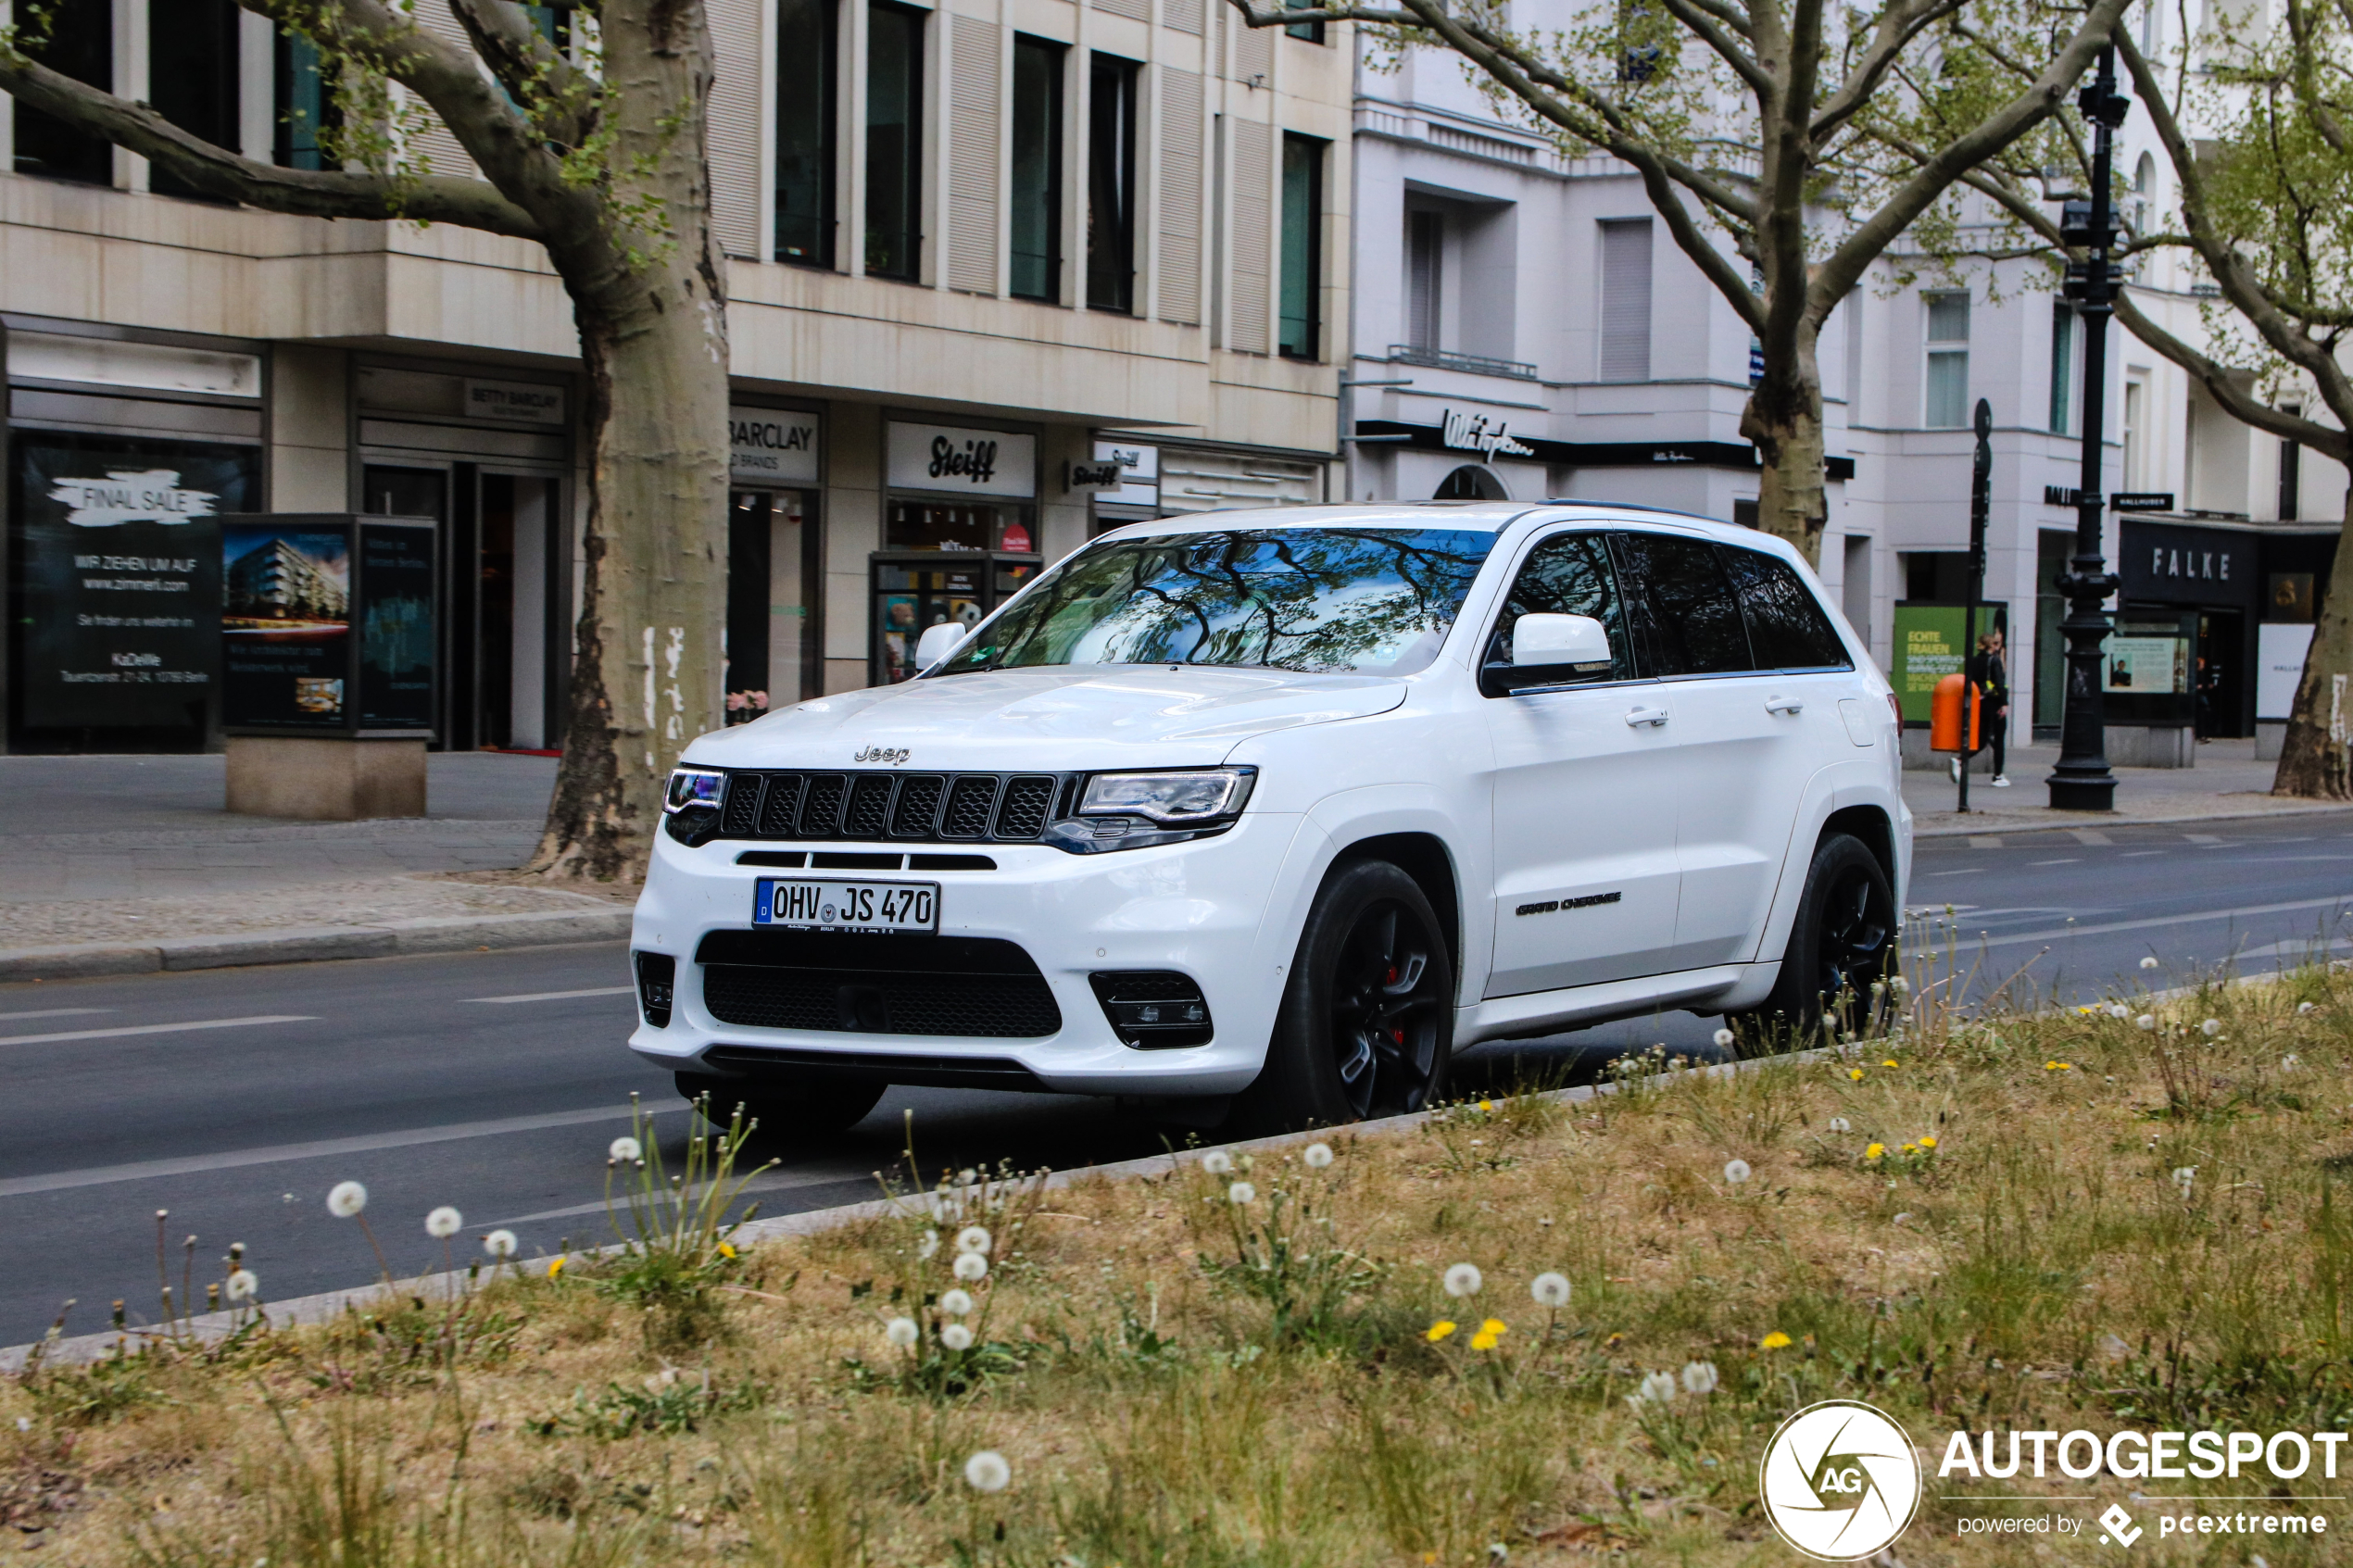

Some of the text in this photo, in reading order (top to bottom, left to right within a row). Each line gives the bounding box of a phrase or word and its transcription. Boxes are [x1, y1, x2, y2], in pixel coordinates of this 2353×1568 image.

[928, 435, 998, 483] Steiff
[1073, 465, 1119, 486] Steiff
[82, 489, 188, 512] FINAL SALE
[2152, 546, 2230, 581] FALKE
[854, 743, 912, 767] Jeep
[761, 906, 767, 916] D
[774, 885, 932, 923] OHV JS 470
[1516, 891, 1621, 916] GRAND CHEROKEE
